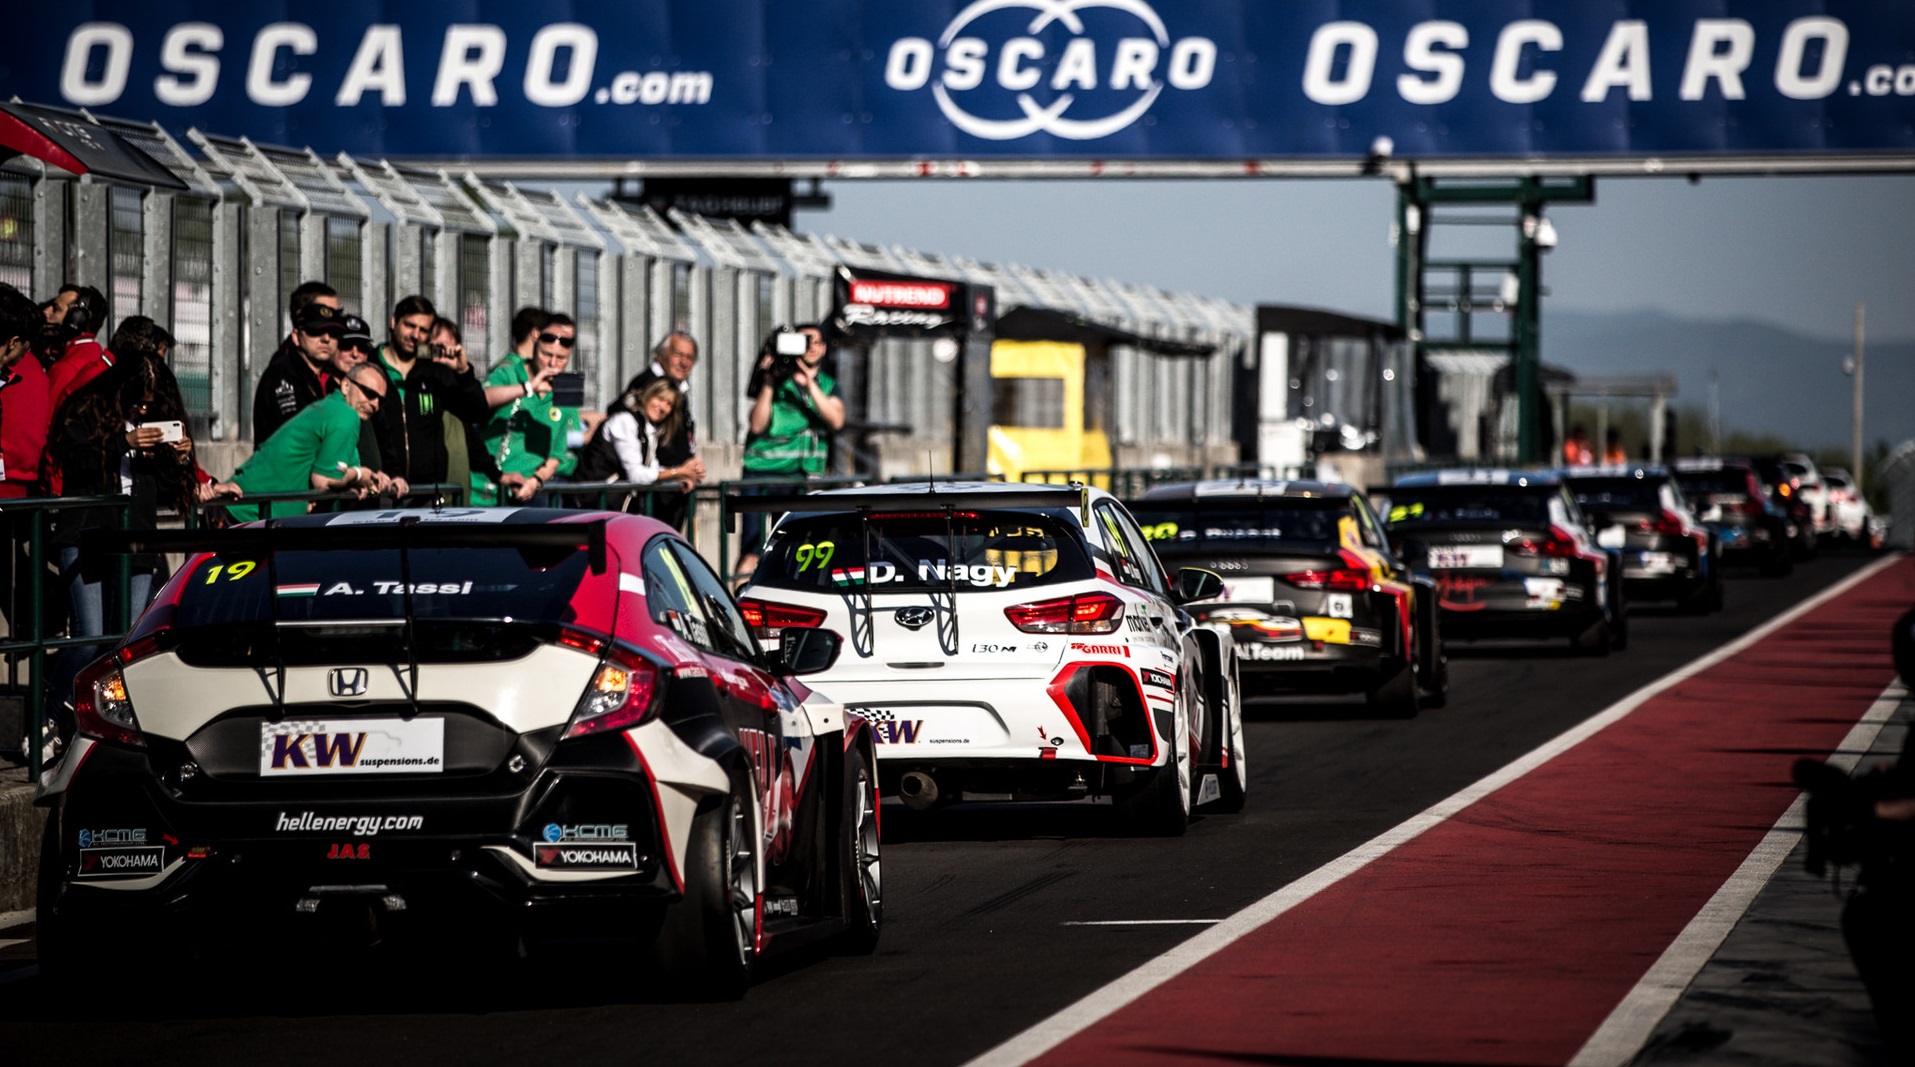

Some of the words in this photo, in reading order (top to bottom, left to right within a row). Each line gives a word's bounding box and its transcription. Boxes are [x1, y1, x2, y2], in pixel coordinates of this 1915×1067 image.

[885, 37, 1218, 90] OSCARO
[853, 284, 946, 306] NUTREND
[795, 540, 835, 573] 99
[206, 560, 256, 585] 19
[869, 561, 905, 584] D.
[918, 558, 1018, 588] Nagy
[324, 582, 365, 596] A.
[372, 581, 473, 596] Tassi
[271, 731, 368, 769] KW
[359, 756, 440, 768] suspensions.de
[275, 811, 423, 836] hellenergy.com
[100, 854, 159, 869] YOKOHAMA
[326, 843, 370, 859] JAS
[560, 850, 632, 863] YOKOHAMA
